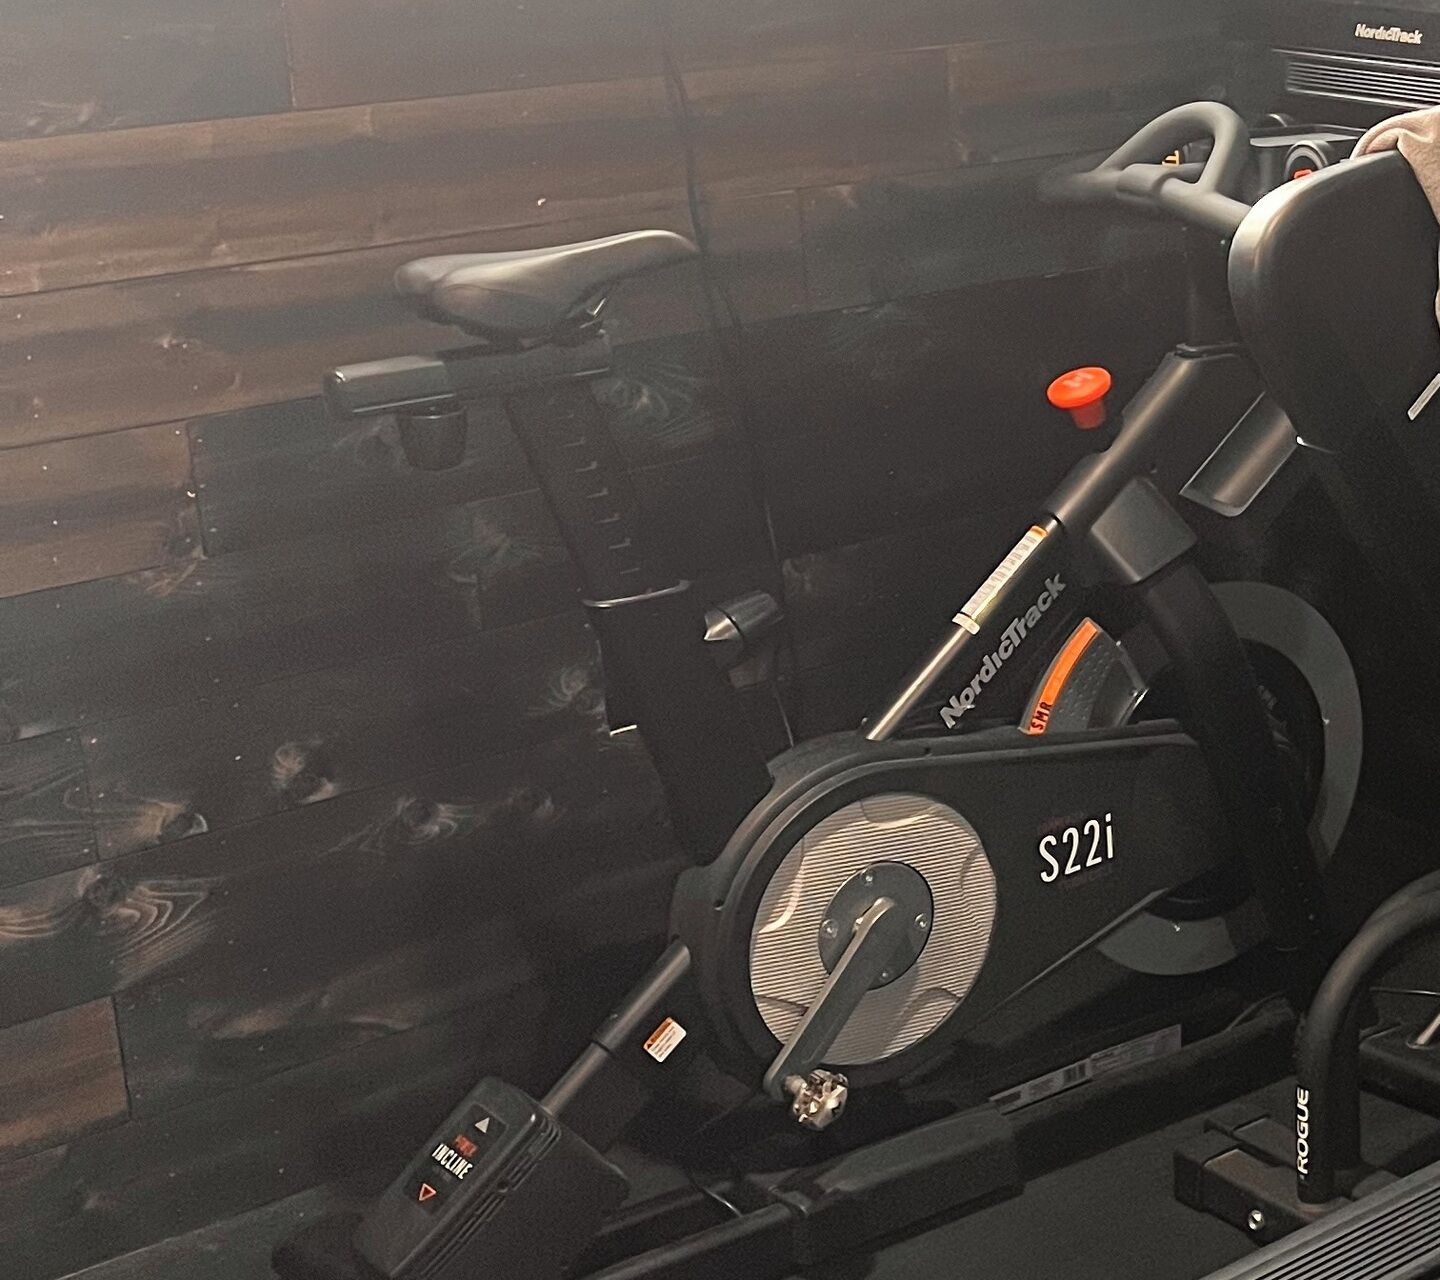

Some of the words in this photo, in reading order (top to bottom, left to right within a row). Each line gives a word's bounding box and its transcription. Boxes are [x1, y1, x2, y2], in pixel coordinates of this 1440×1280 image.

[1355, 23, 1423, 45] NordicTrack
[938, 571, 1067, 730] NordicTrack
[1030, 701, 1054, 731] SMR
[1038, 812, 1114, 884] S22i
[1296, 1087, 1310, 1175] ROGUE
[431, 1143, 474, 1180] INCLINE
